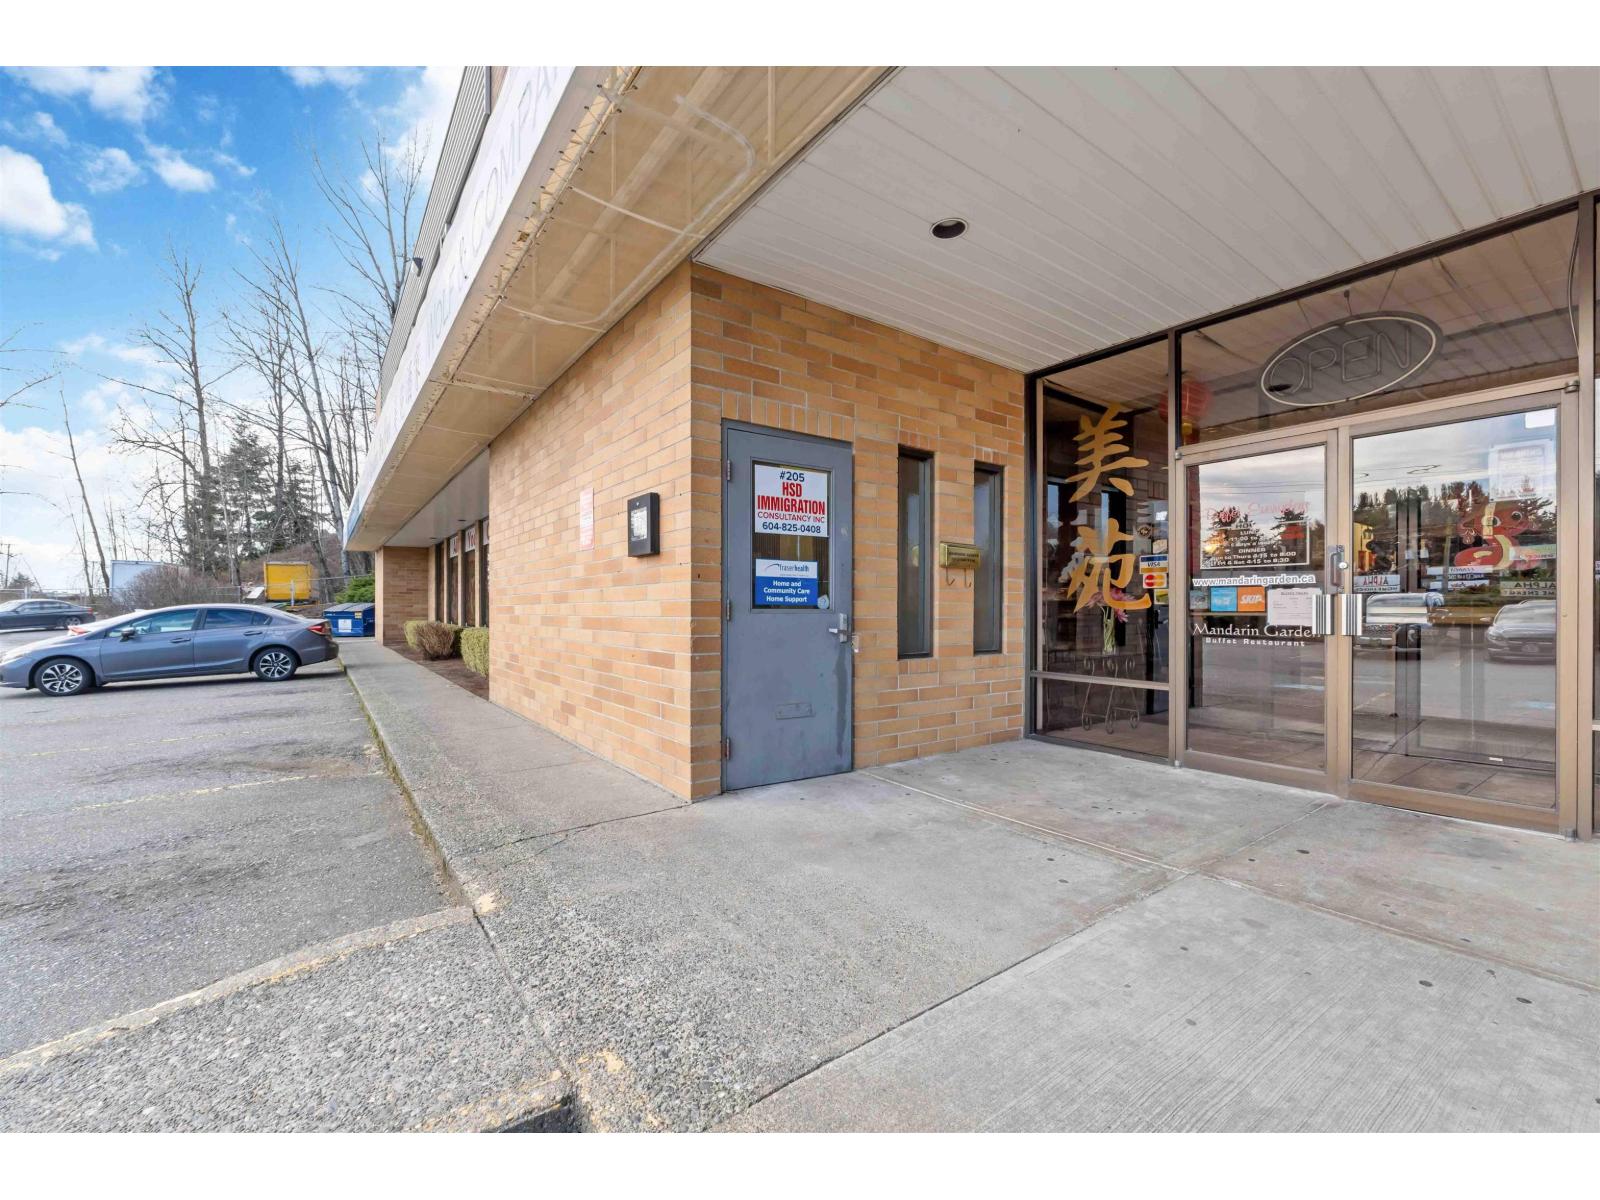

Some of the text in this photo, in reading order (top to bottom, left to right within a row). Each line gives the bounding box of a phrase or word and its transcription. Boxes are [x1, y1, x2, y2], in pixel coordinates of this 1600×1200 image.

[471, 66, 557, 257] COMPA
[1269, 325, 1412, 396] OPEN
[779, 470, 805, 482] #205
[782, 482, 803, 497] HSD
[757, 495, 826, 515] IMMIGRATION
[757, 511, 825, 524] CONSULTANCY INC
[762, 522, 822, 534] 604-825-0408
[1193, 574, 1316, 586] www.mandaringarden.ca
[1192, 623, 1320, 638] Mandarin Garde
[1205, 637, 1305, 647] Buffet Restaurant
